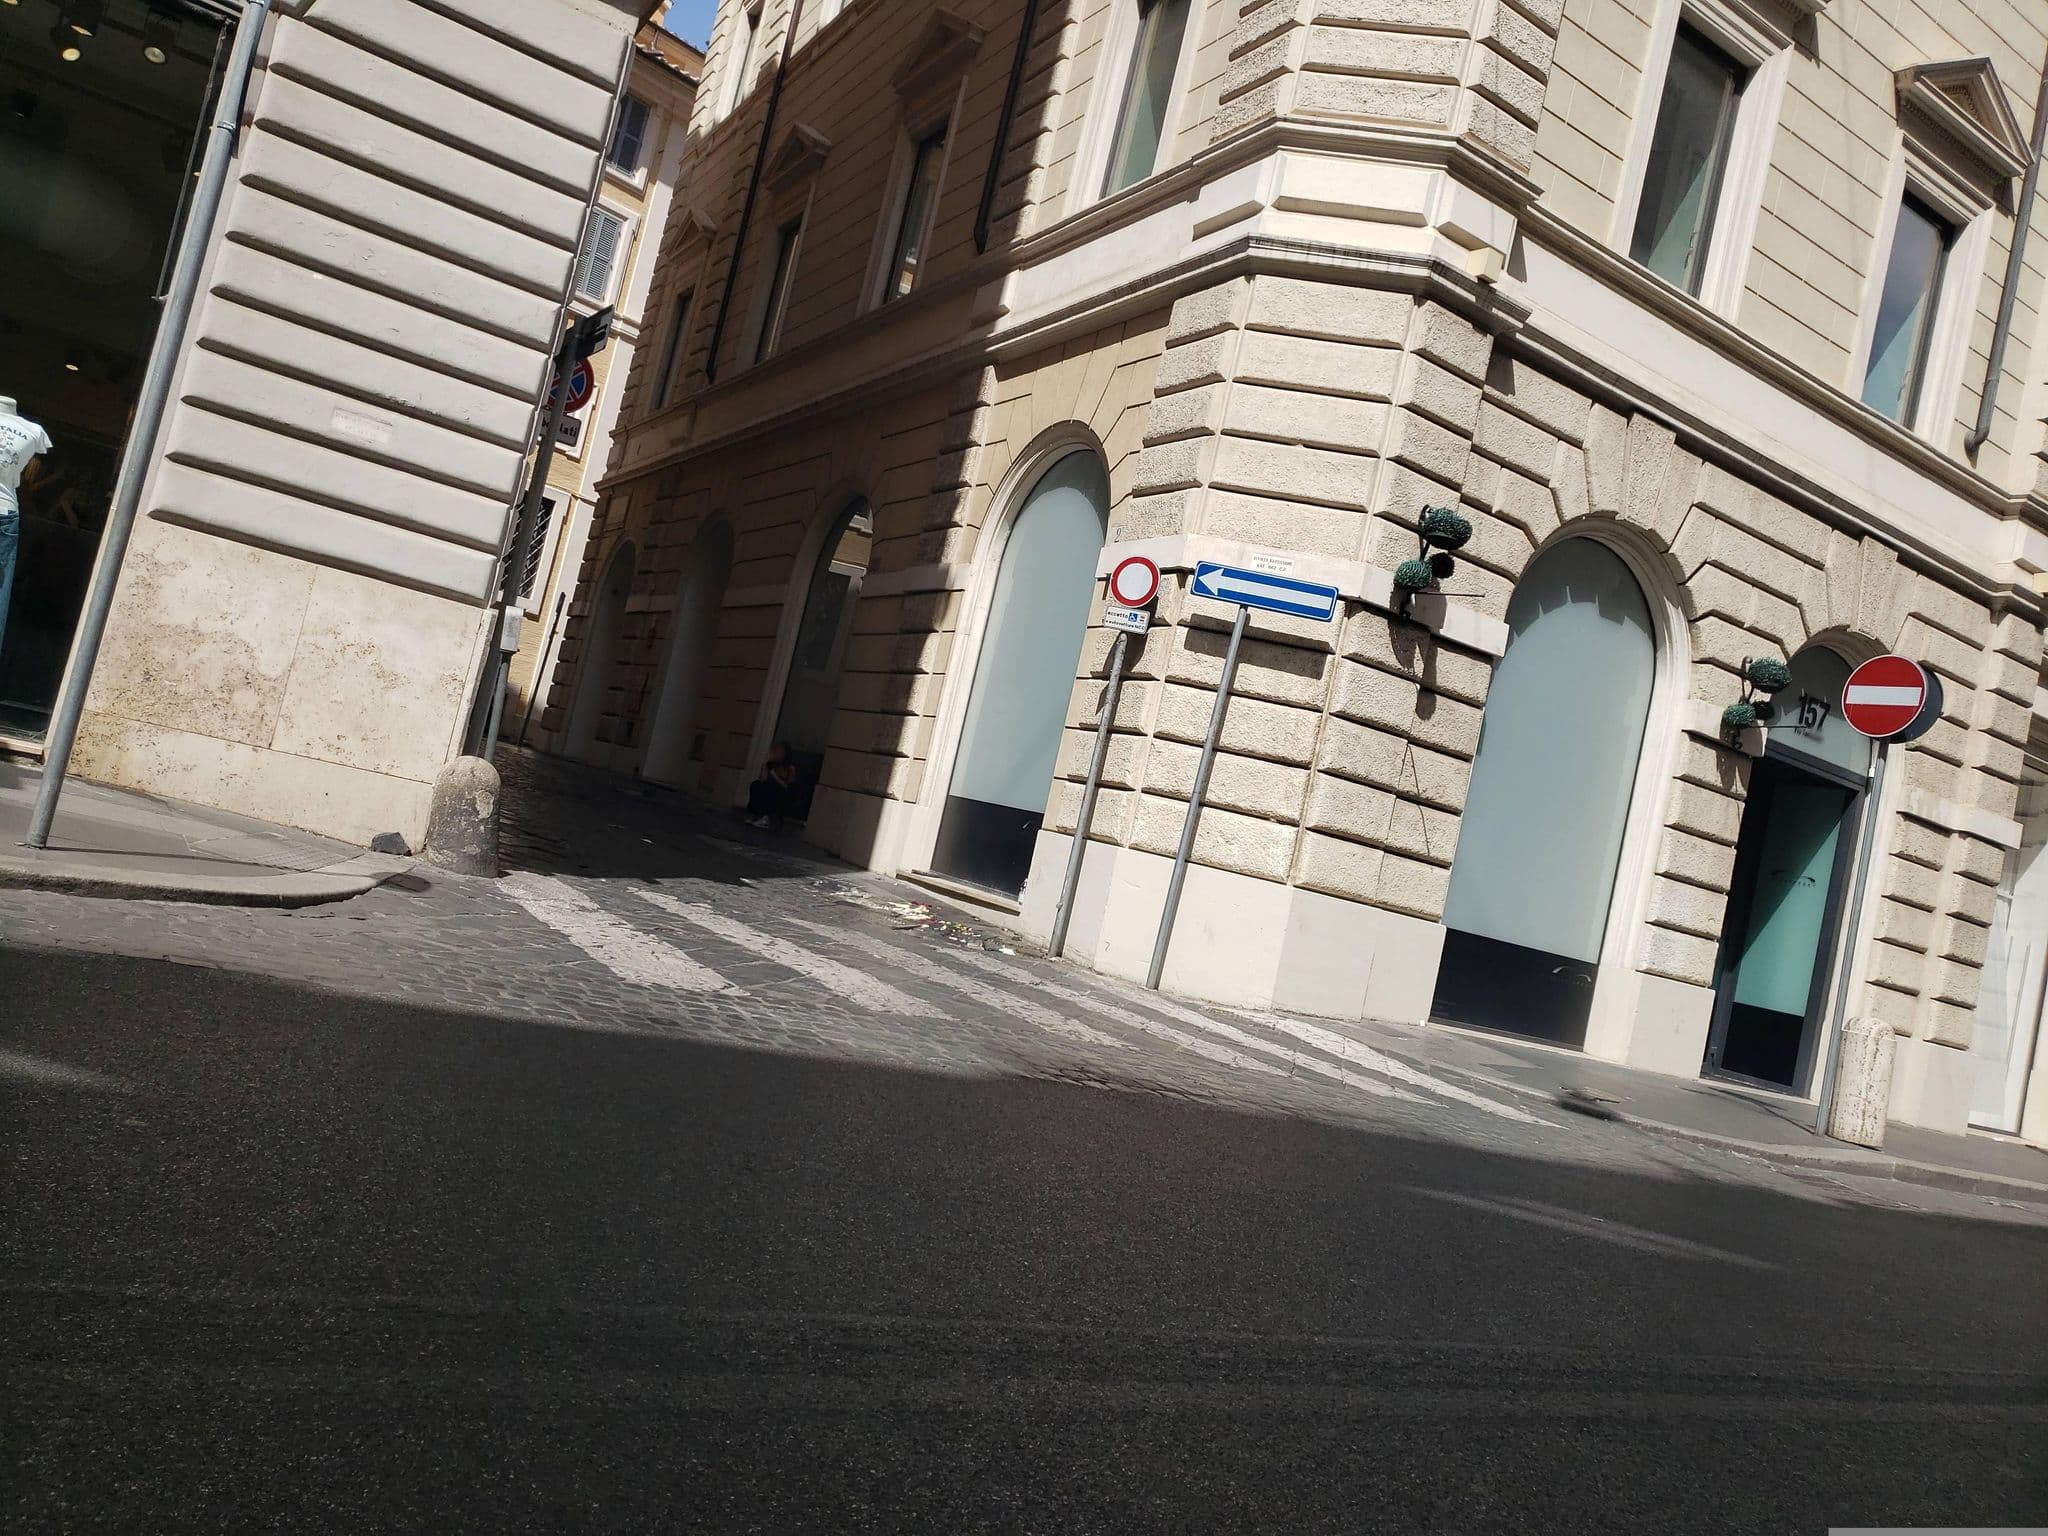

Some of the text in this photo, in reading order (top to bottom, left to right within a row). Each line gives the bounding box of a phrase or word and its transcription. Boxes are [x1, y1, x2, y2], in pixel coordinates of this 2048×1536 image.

[0, 425, 28, 440] TALIA
[1113, 527, 1122, 543] 2
[1799, 692, 1831, 731] 157
